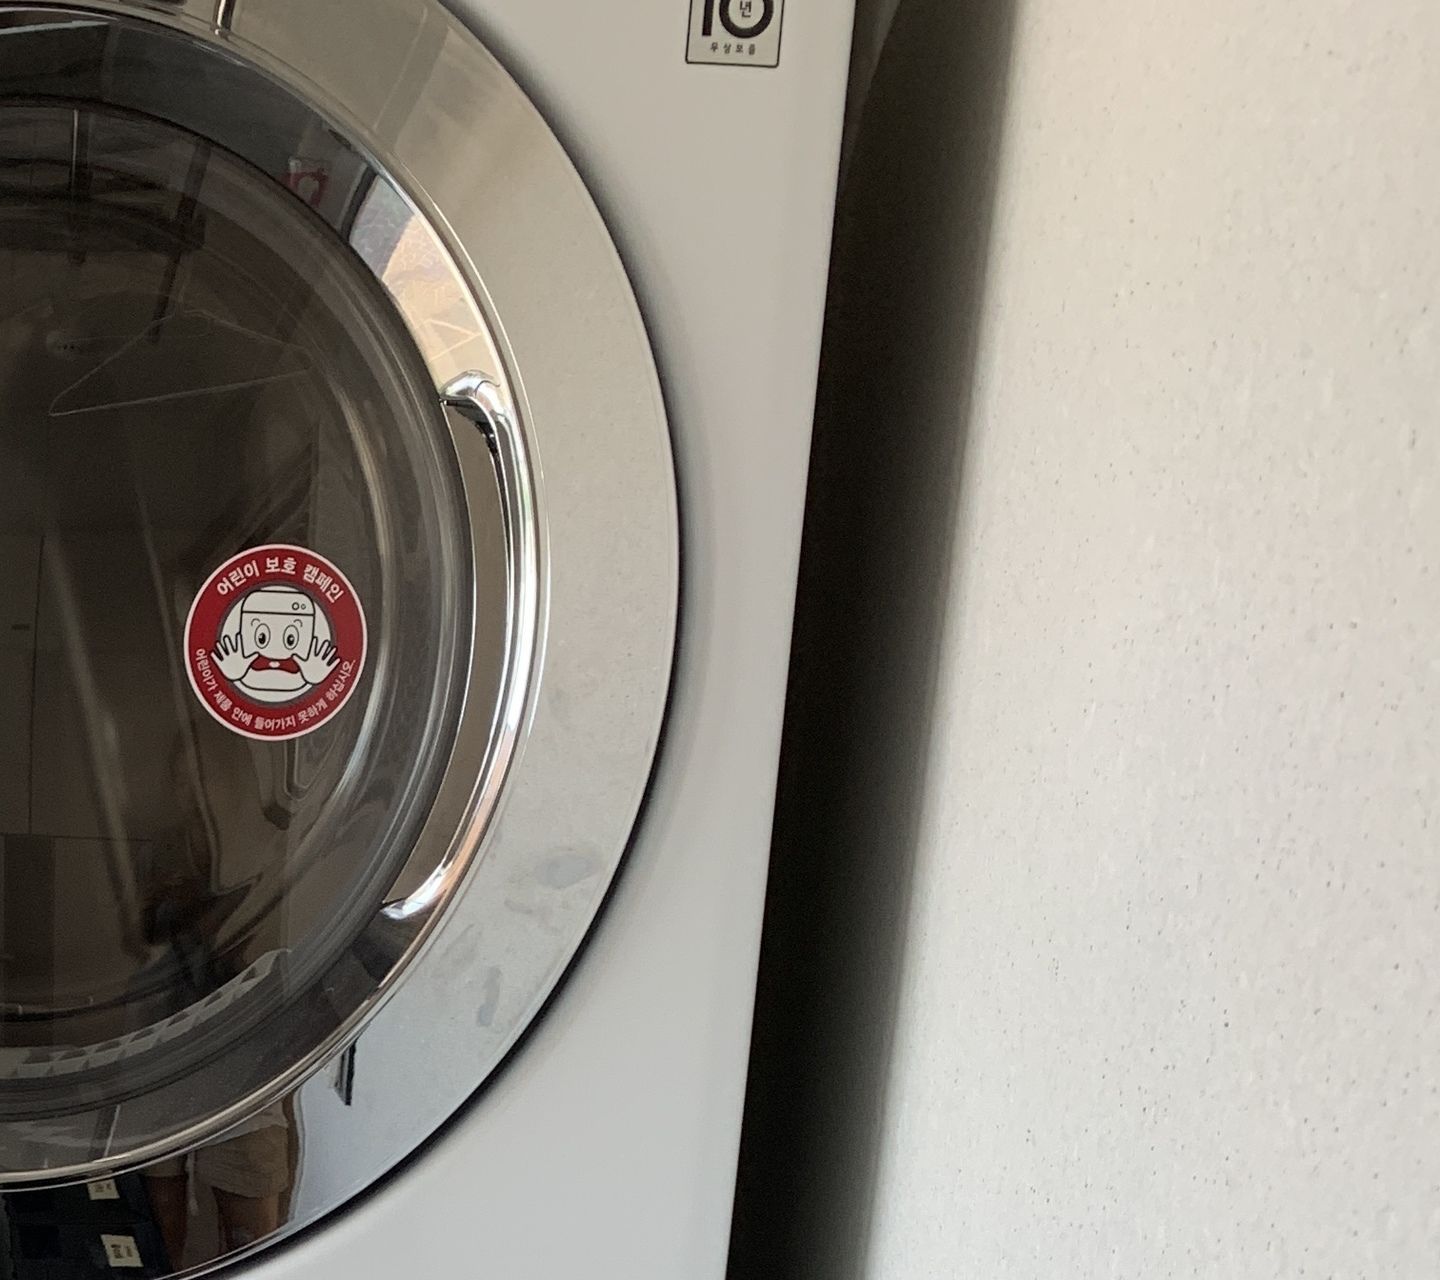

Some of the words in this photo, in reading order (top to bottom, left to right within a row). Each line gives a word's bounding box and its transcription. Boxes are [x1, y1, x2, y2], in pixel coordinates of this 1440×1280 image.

[217, 560, 260, 596] 어린이
[265, 557, 297, 574] 보호
[303, 564, 344, 603] 캠페인
[195, 648, 217, 692] 어린이가
[214, 691, 231, 712] 제품
[232, 707, 252, 727] 안에
[255, 715, 296, 731] 들어가지
[298, 700, 329, 721] 못하게
